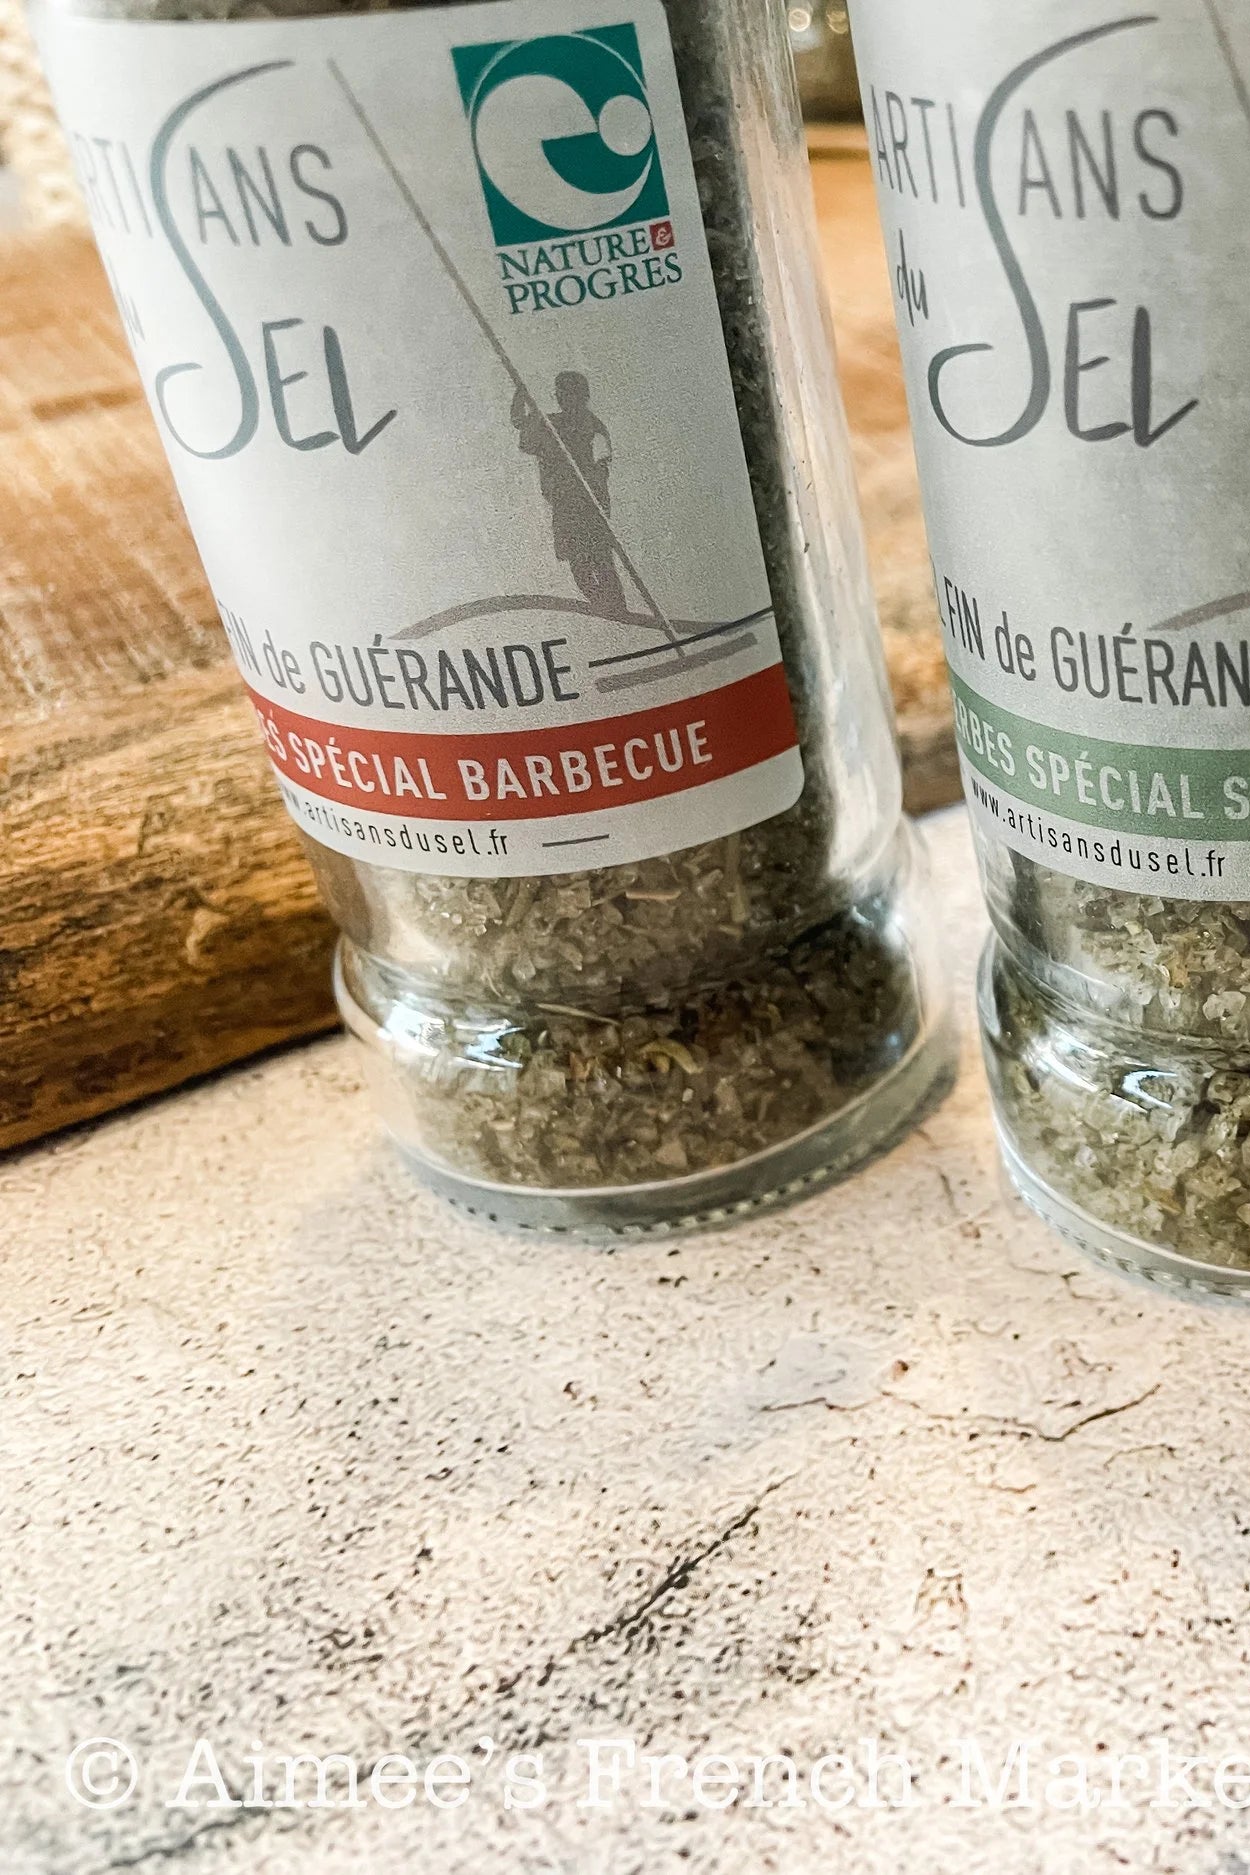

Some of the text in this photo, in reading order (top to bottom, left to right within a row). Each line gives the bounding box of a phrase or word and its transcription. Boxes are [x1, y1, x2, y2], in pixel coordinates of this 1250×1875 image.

[496, 228, 650, 280] NATURE
[504, 252, 682, 314] PROGRES
[896, 228, 928, 327] du
[944, 576, 985, 661] FIN
[995, 611, 1036, 681] de
[263, 629, 580, 712] de GUÉRANDE
[288, 732, 446, 801] SPÉCIAL
[457, 720, 713, 801] BARBECUE
[1025, 743, 1205, 821] SPÉCIAL
[971, 777, 1225, 879] www.artisansdusel.fr
